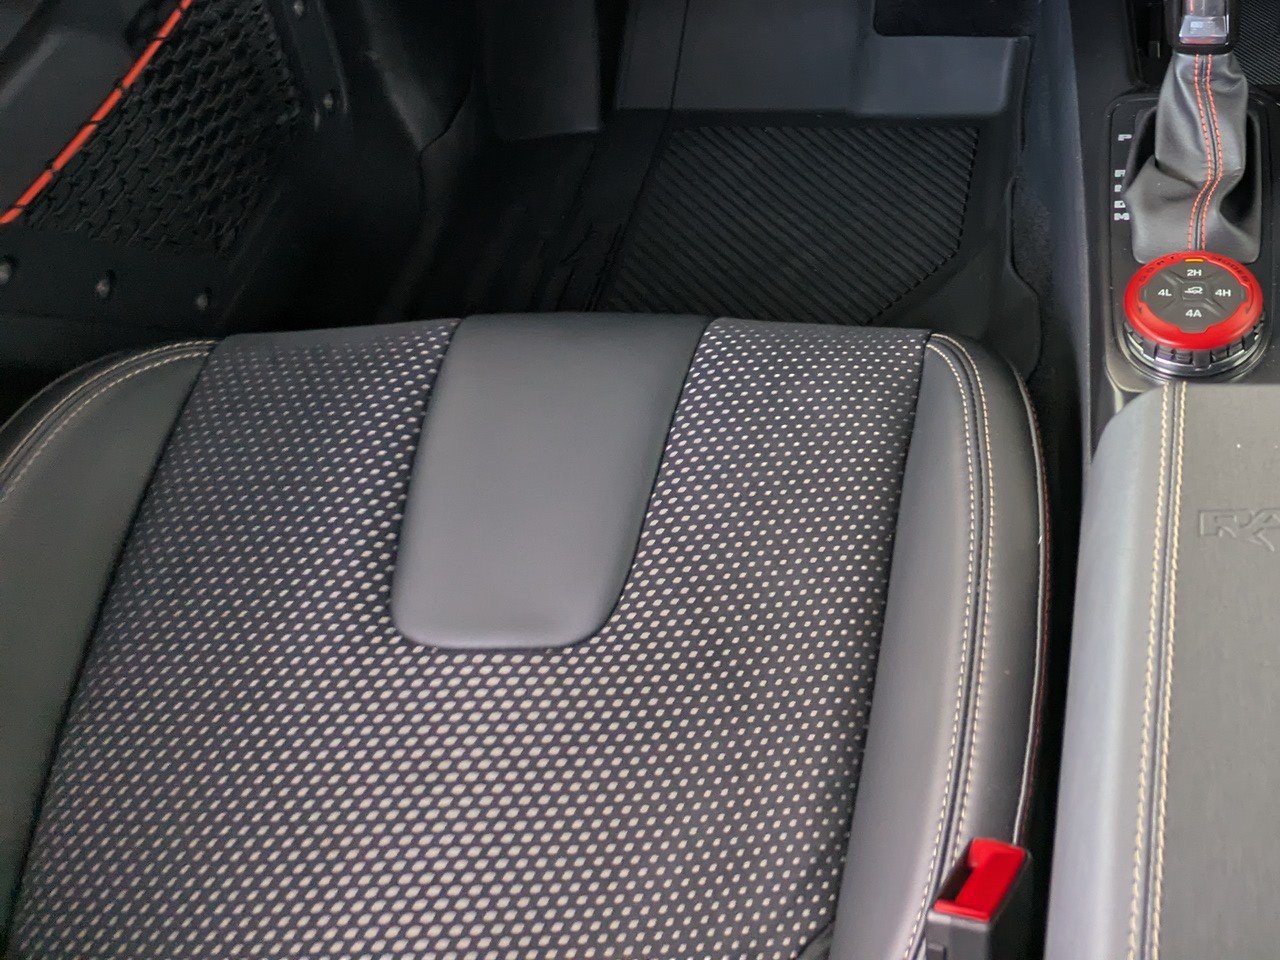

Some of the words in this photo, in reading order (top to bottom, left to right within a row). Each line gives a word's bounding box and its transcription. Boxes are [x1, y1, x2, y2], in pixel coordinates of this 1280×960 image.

[1186, 269, 1202, 277] 2H
[1157, 289, 1172, 297] 4L
[1214, 289, 1232, 297] 4H
[1185, 309, 1203, 318] 4A
